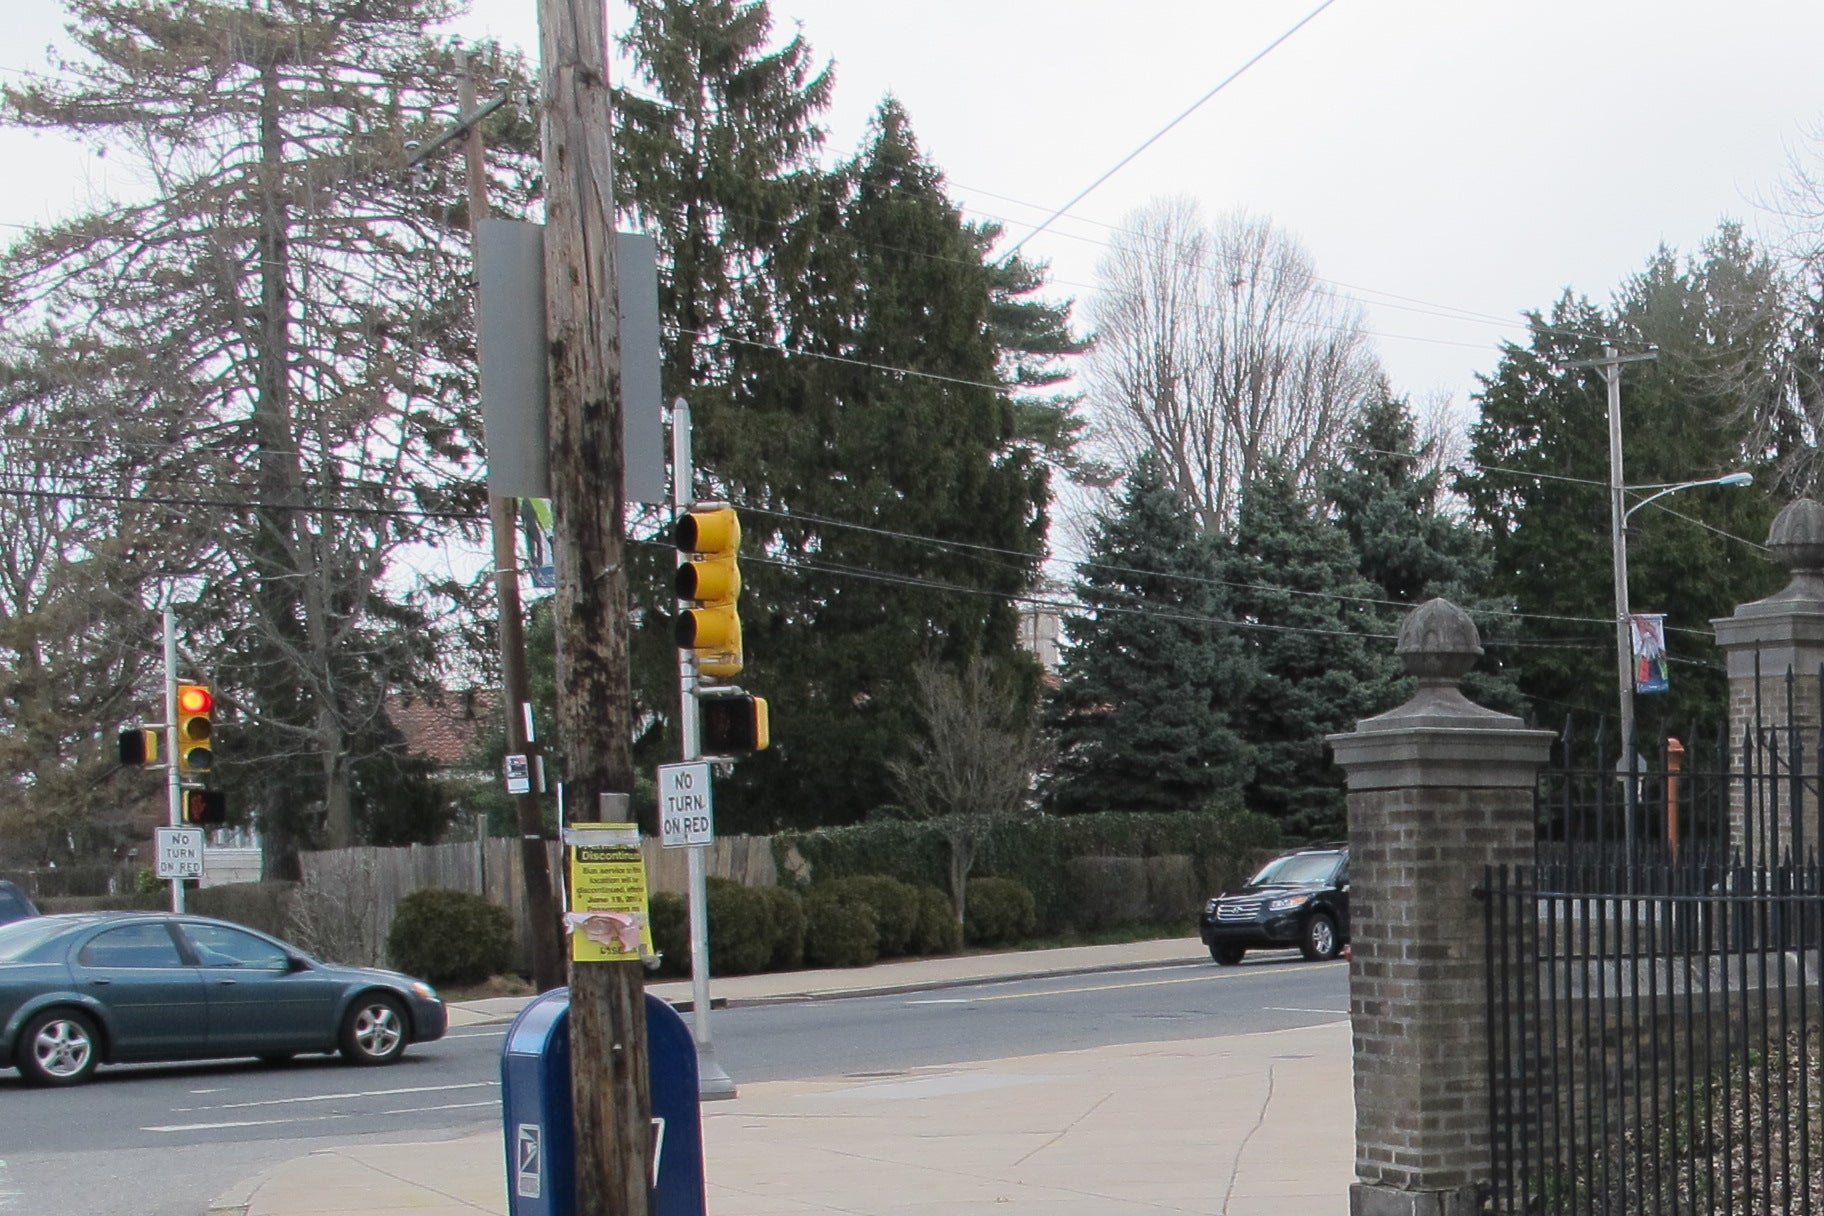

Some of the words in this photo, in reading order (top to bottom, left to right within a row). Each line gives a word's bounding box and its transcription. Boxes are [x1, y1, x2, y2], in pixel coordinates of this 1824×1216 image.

[675, 772, 693, 790] NO
[668, 795, 704, 812] TURN
[664, 818, 680, 835] ON
[683, 816, 709, 833] RED
[172, 833, 190, 845] NO
[166, 848, 195, 858] TURN
[160, 862, 174, 872] ON
[180, 862, 200, 873] RED
